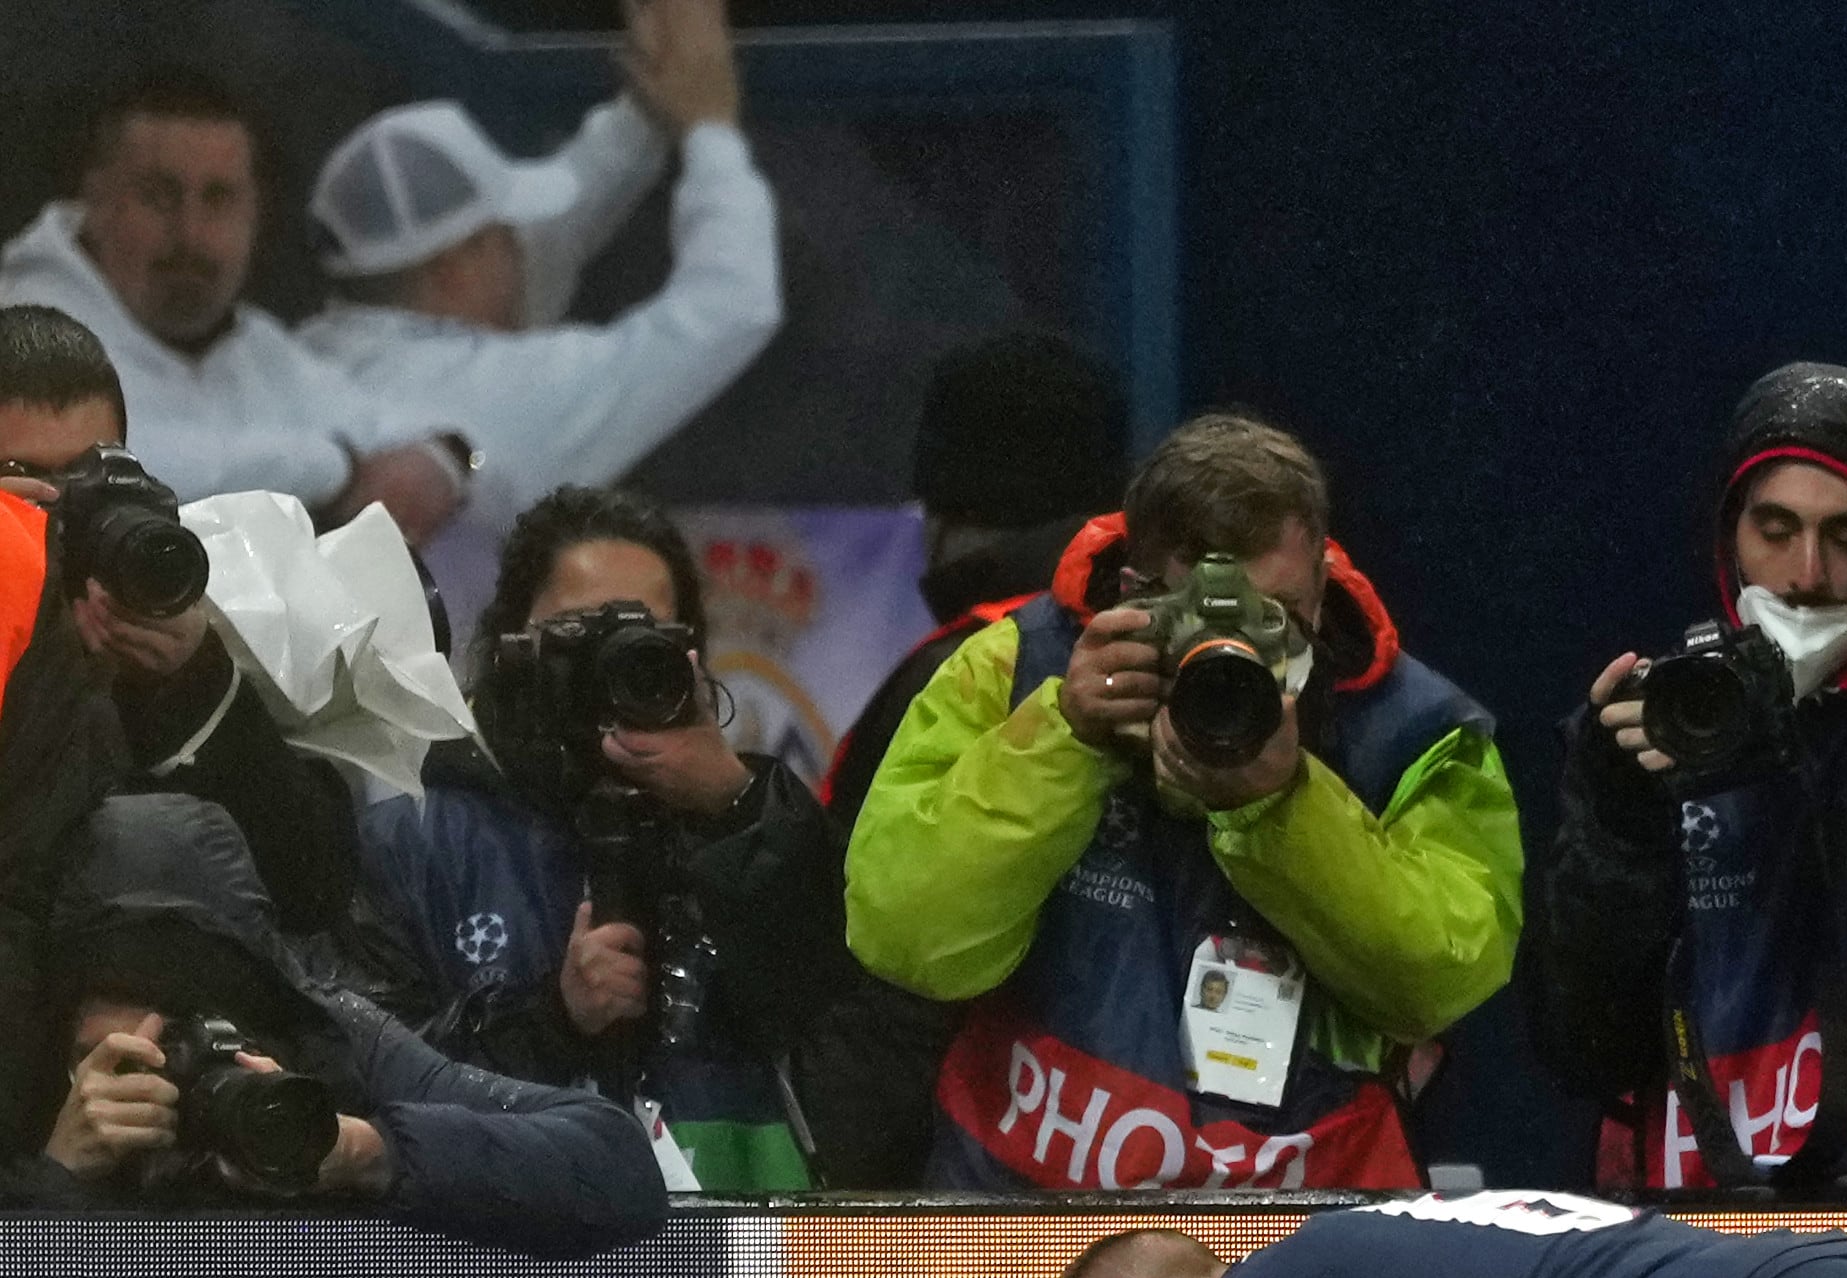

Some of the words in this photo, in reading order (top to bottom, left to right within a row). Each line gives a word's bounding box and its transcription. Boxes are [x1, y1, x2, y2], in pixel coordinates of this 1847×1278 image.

[1686, 632, 1720, 648] Nikon
[1687, 892, 1741, 911] AGUE
[998, 1040, 1315, 1190] PHOTO
